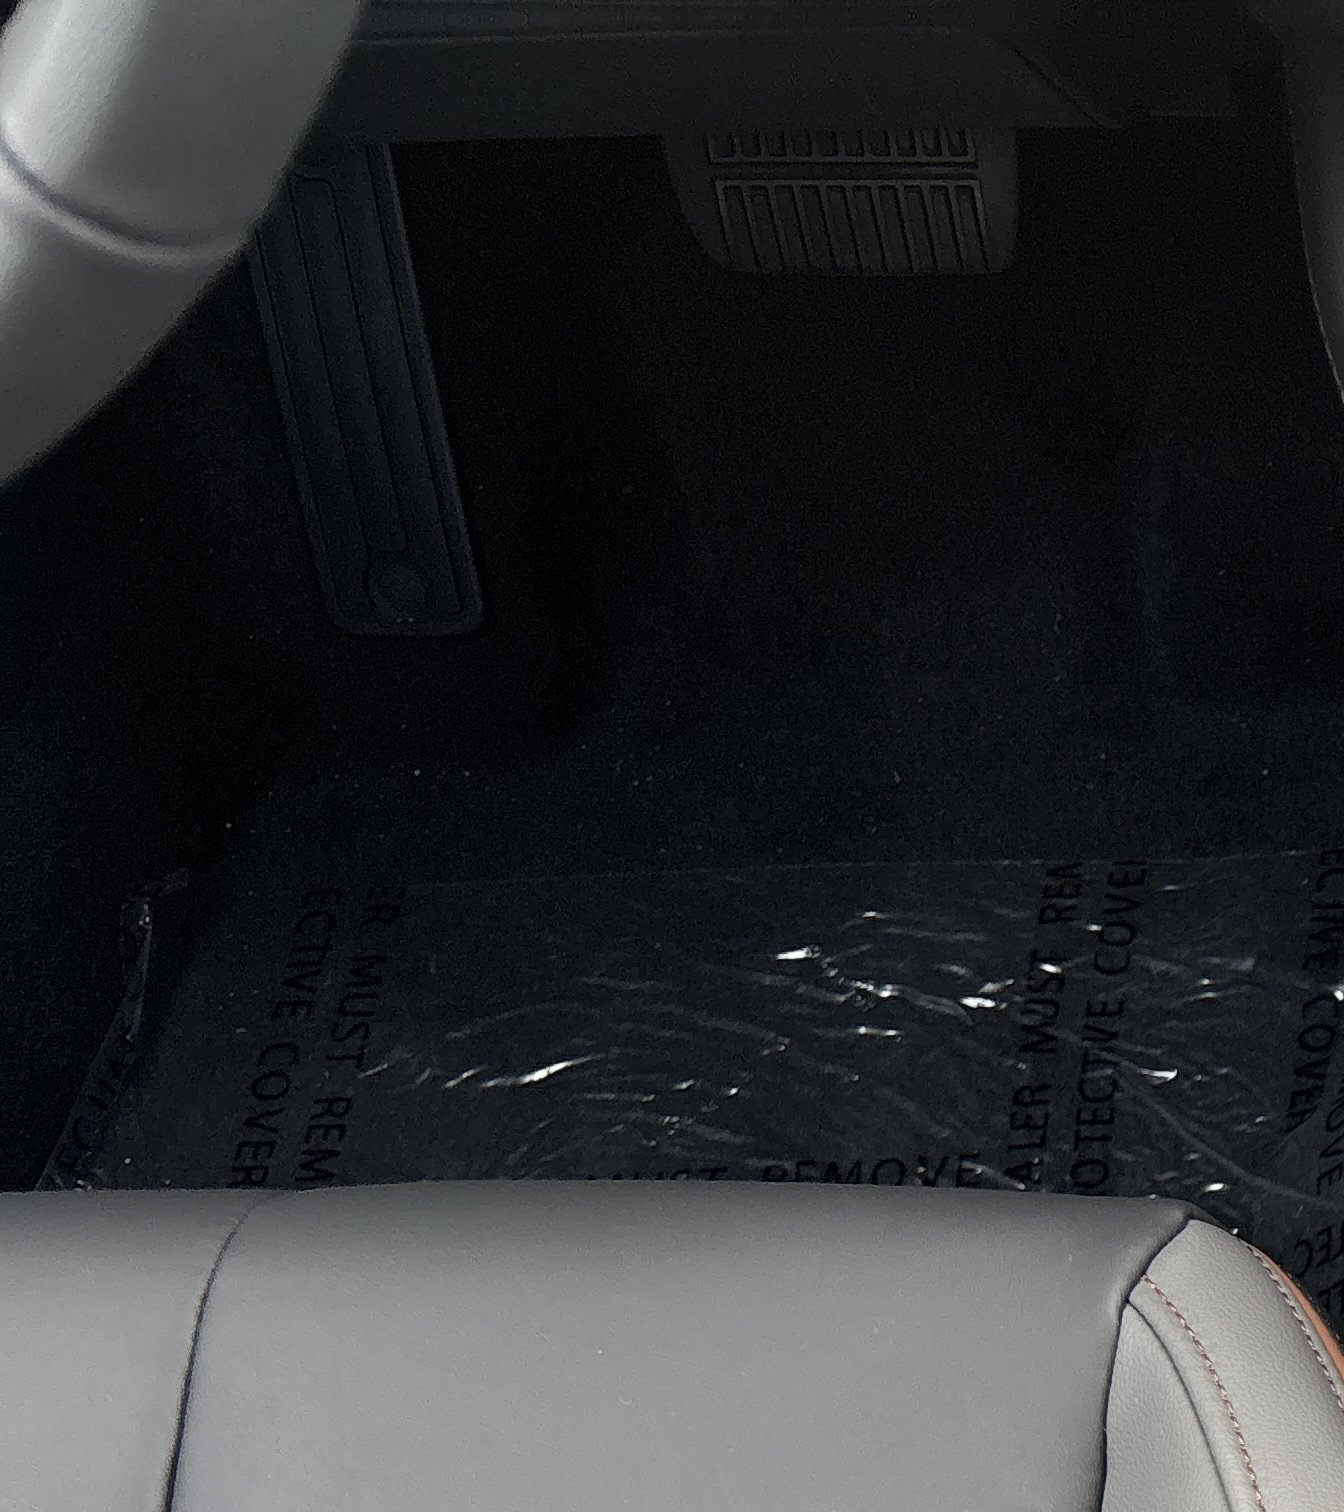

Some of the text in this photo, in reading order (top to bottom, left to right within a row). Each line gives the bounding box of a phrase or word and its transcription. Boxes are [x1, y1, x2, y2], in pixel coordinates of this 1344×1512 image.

[325, 954, 388, 1070] MUST
[1019, 949, 1068, 1053] MUST
[226, 1042, 300, 1189] COVER
